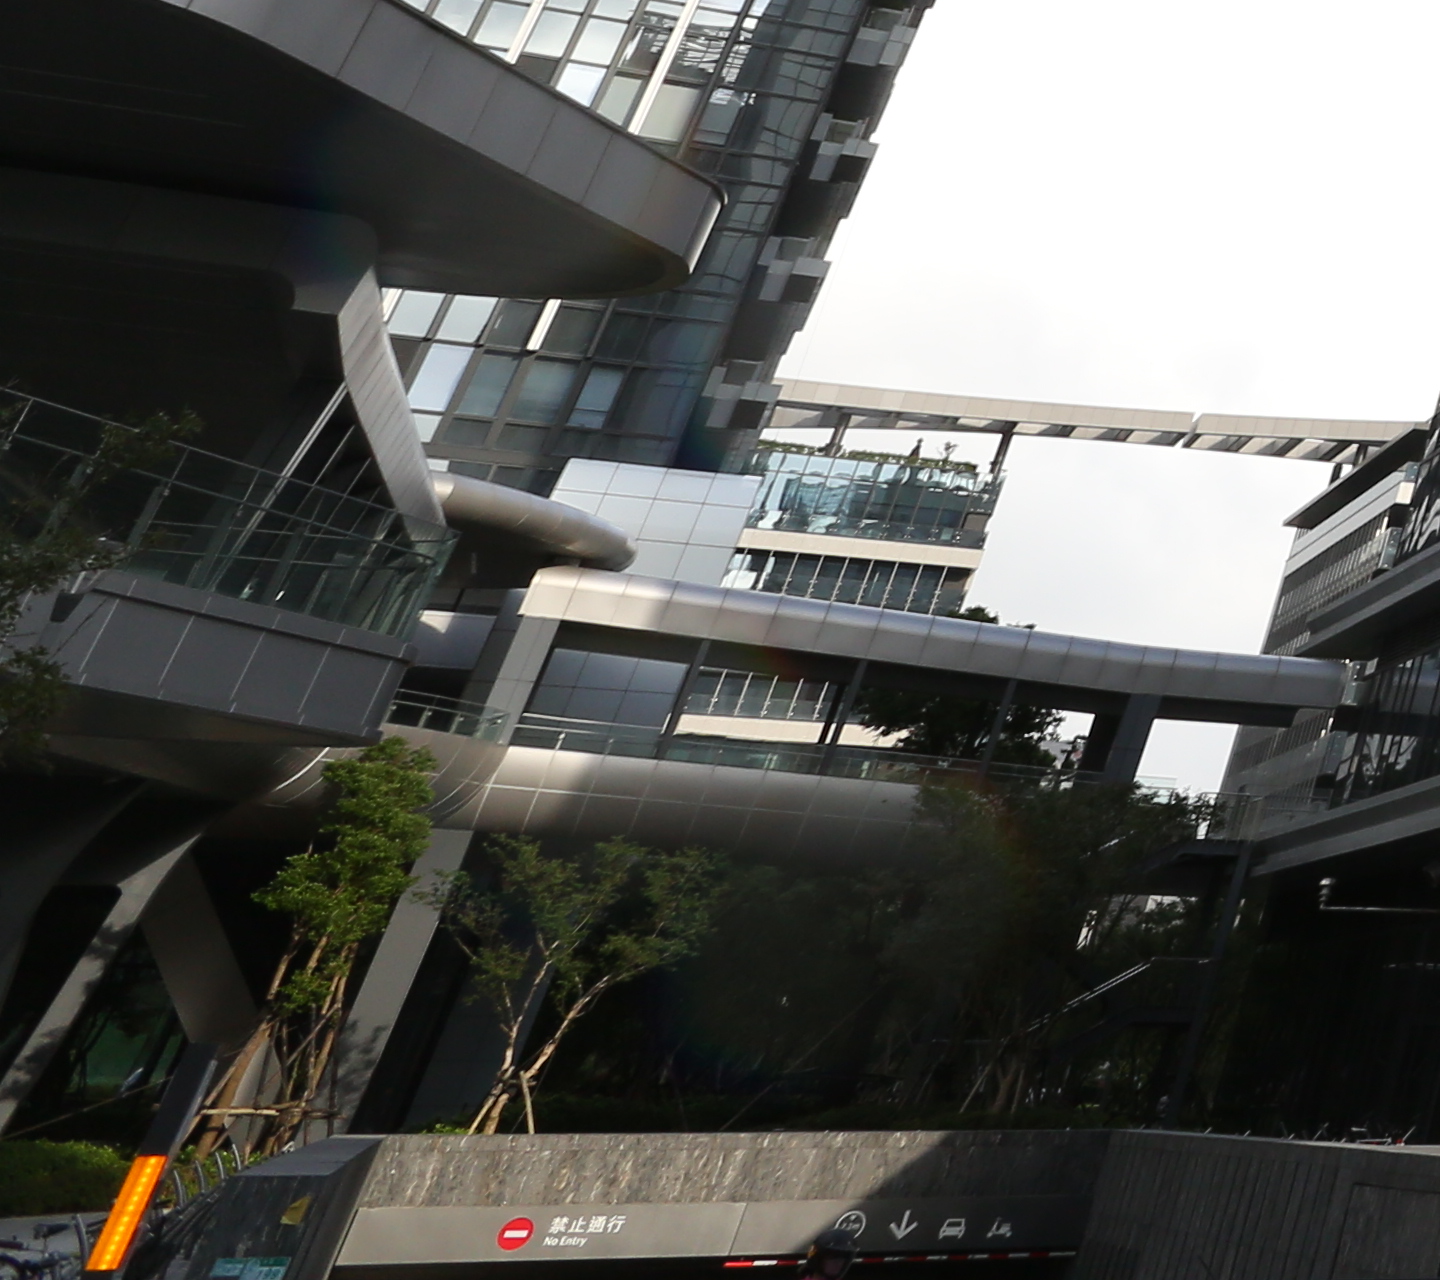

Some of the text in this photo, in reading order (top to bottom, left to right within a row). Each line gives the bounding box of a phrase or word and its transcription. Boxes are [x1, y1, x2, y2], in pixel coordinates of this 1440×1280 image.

[548, 1215, 627, 1234] 禁止通行
[542, 1235, 588, 1248] No Entry
